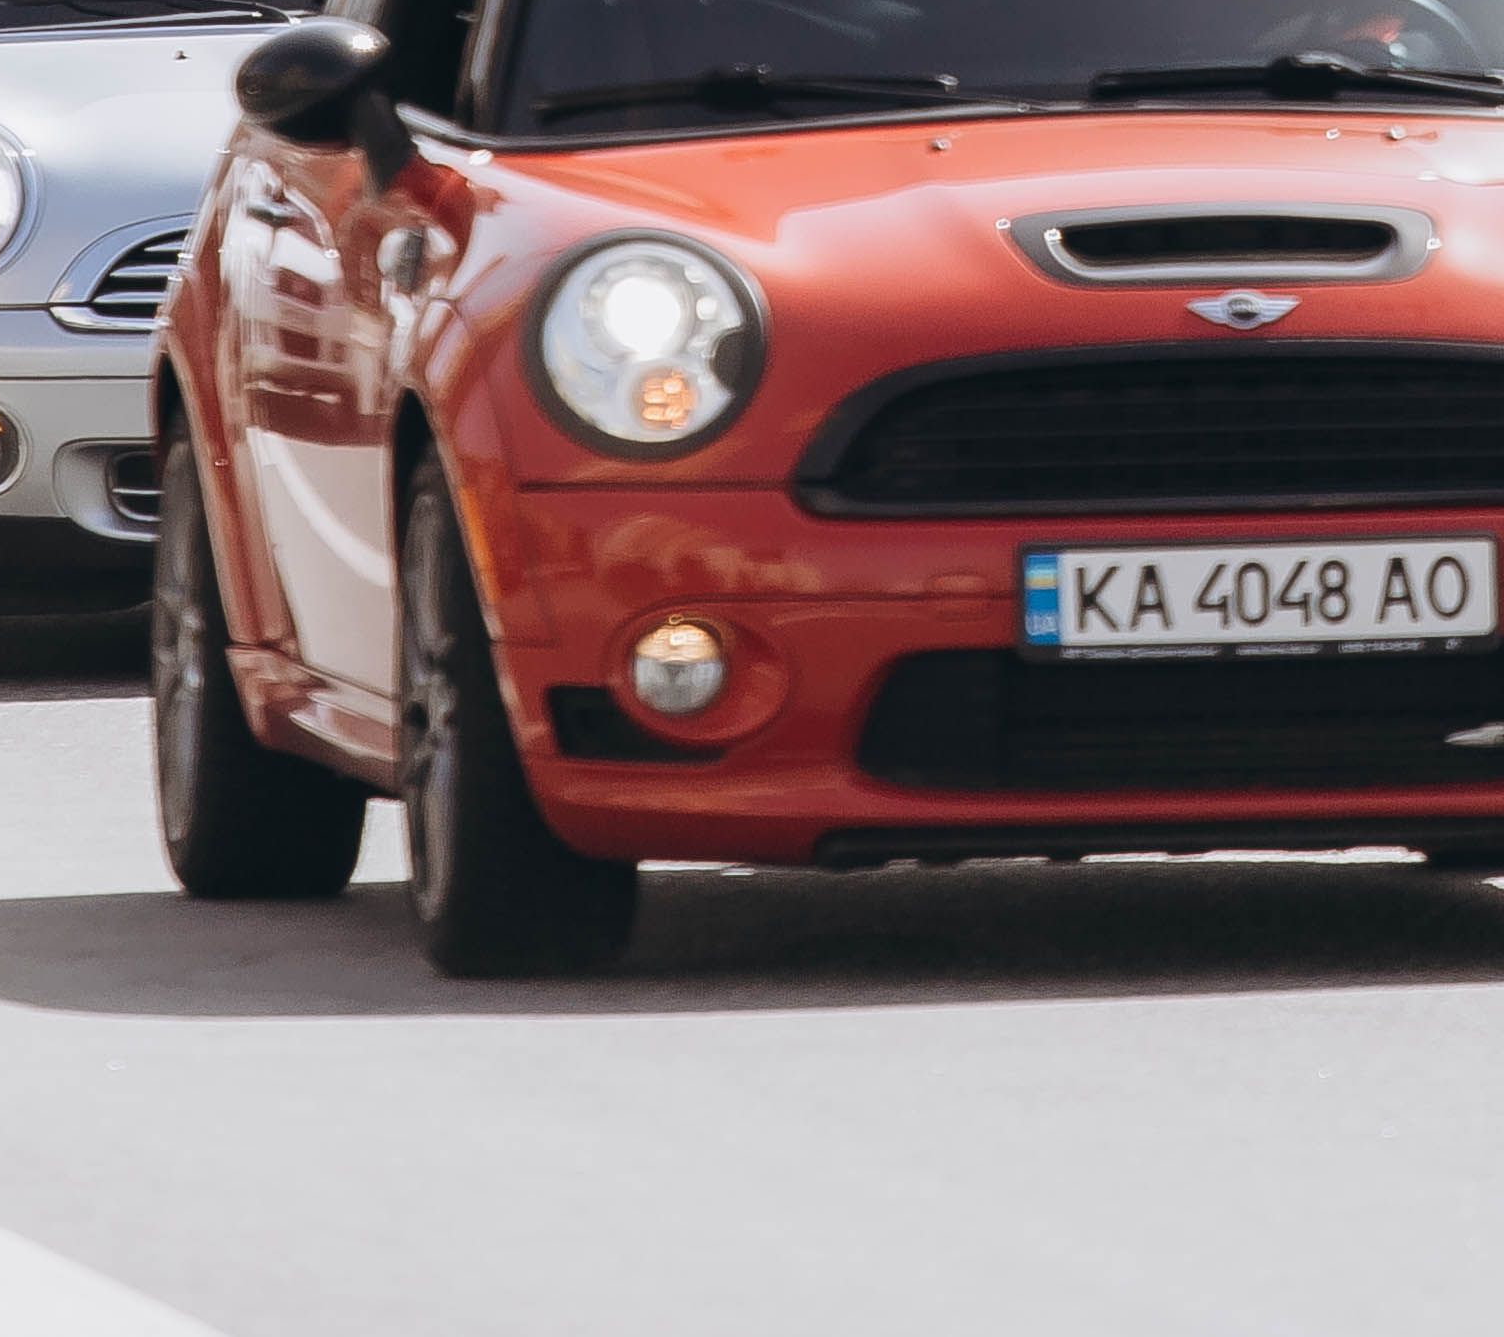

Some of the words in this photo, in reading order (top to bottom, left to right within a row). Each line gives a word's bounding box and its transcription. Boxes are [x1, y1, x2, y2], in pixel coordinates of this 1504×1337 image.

[1075, 564, 1174, 633] KA
[1196, 559, 1351, 628] 4048
[1376, 554, 1470, 623] AO
